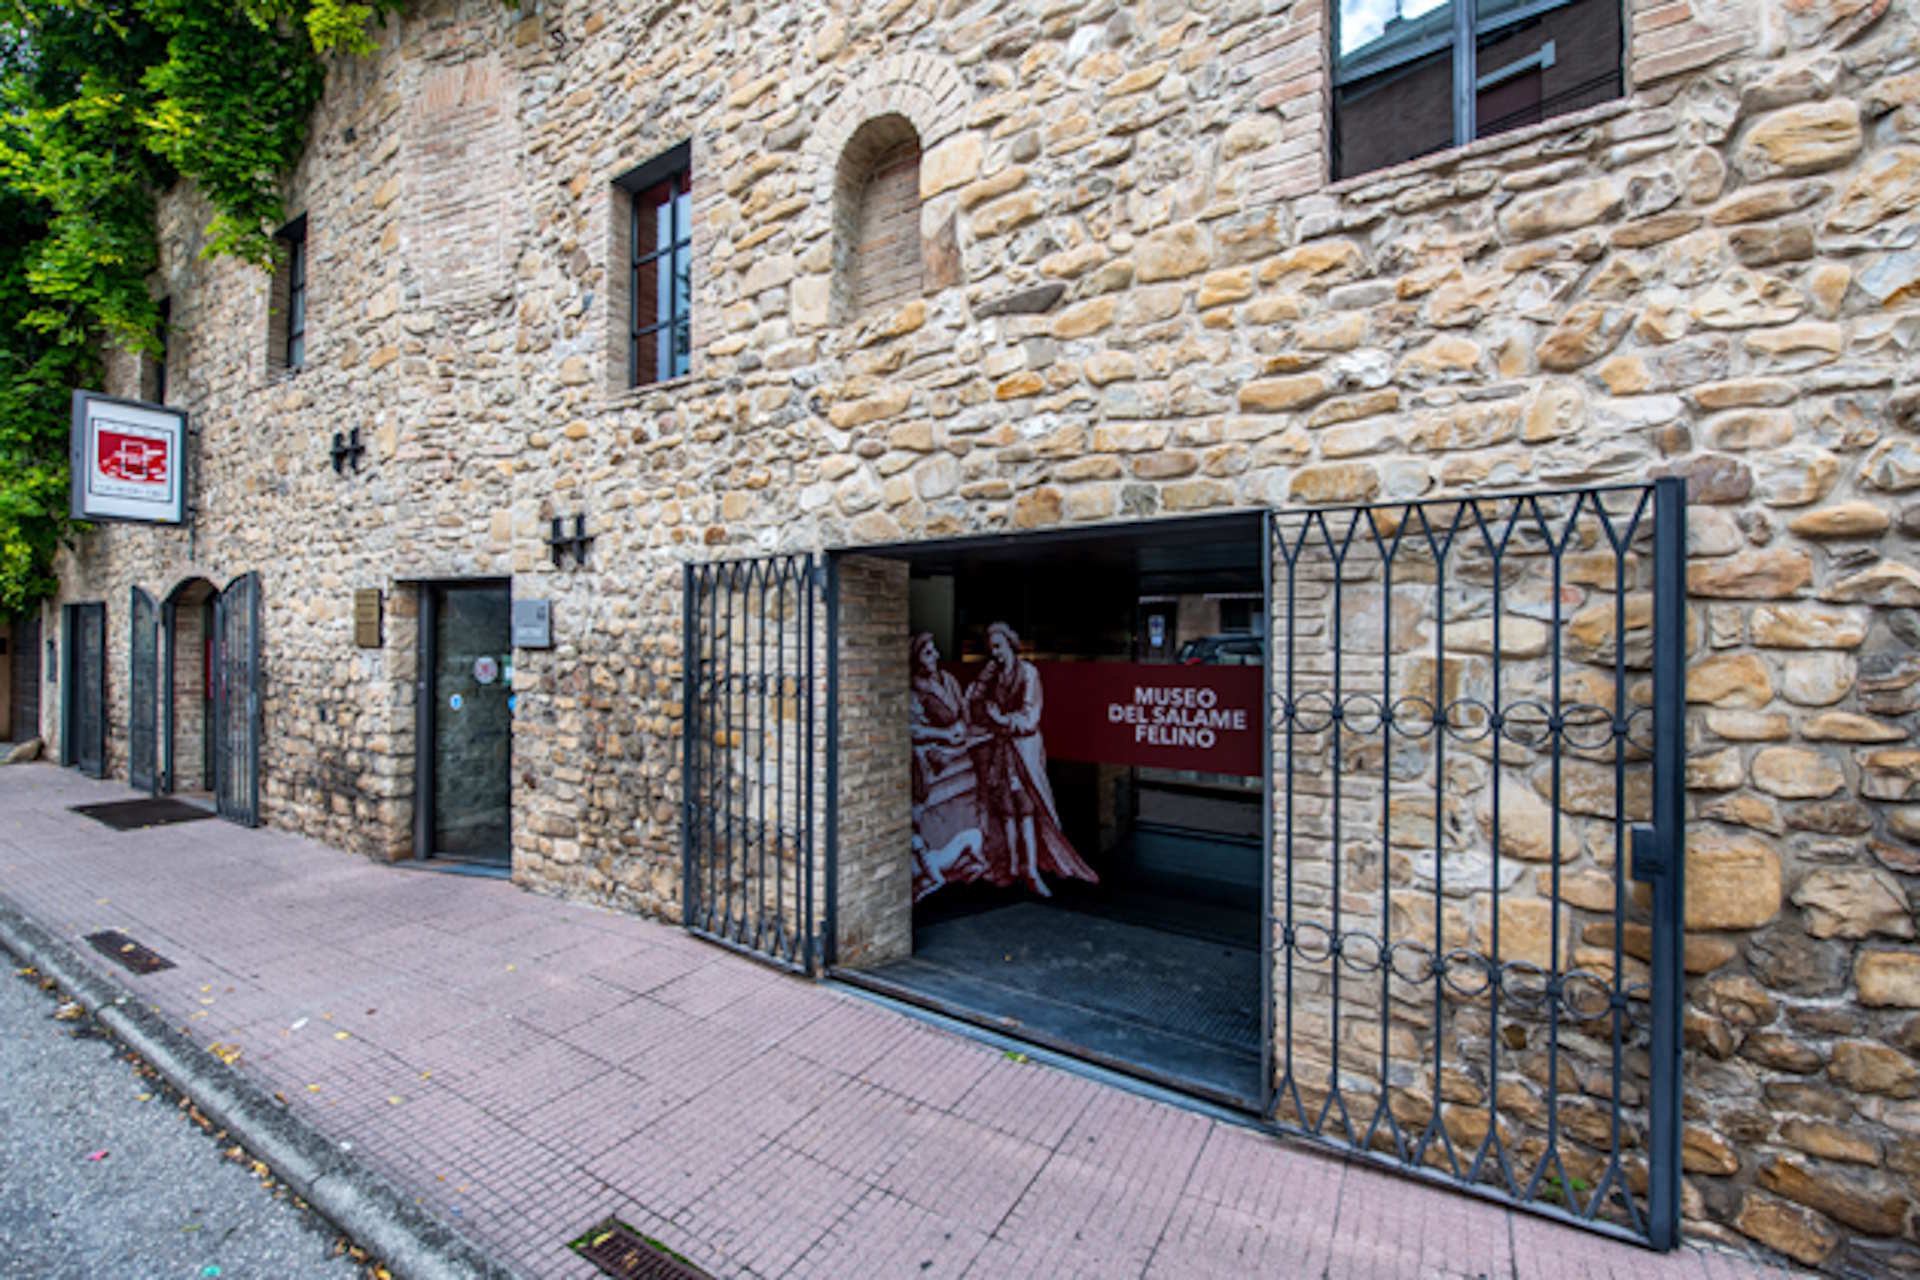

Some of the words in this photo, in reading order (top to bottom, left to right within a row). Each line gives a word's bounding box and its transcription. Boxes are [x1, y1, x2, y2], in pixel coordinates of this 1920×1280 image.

[1134, 686, 1217, 709] MUSEO
[1108, 703, 1149, 724] DEL
[1151, 706, 1248, 730] SALAME
[1135, 724, 1216, 749] FELINO
